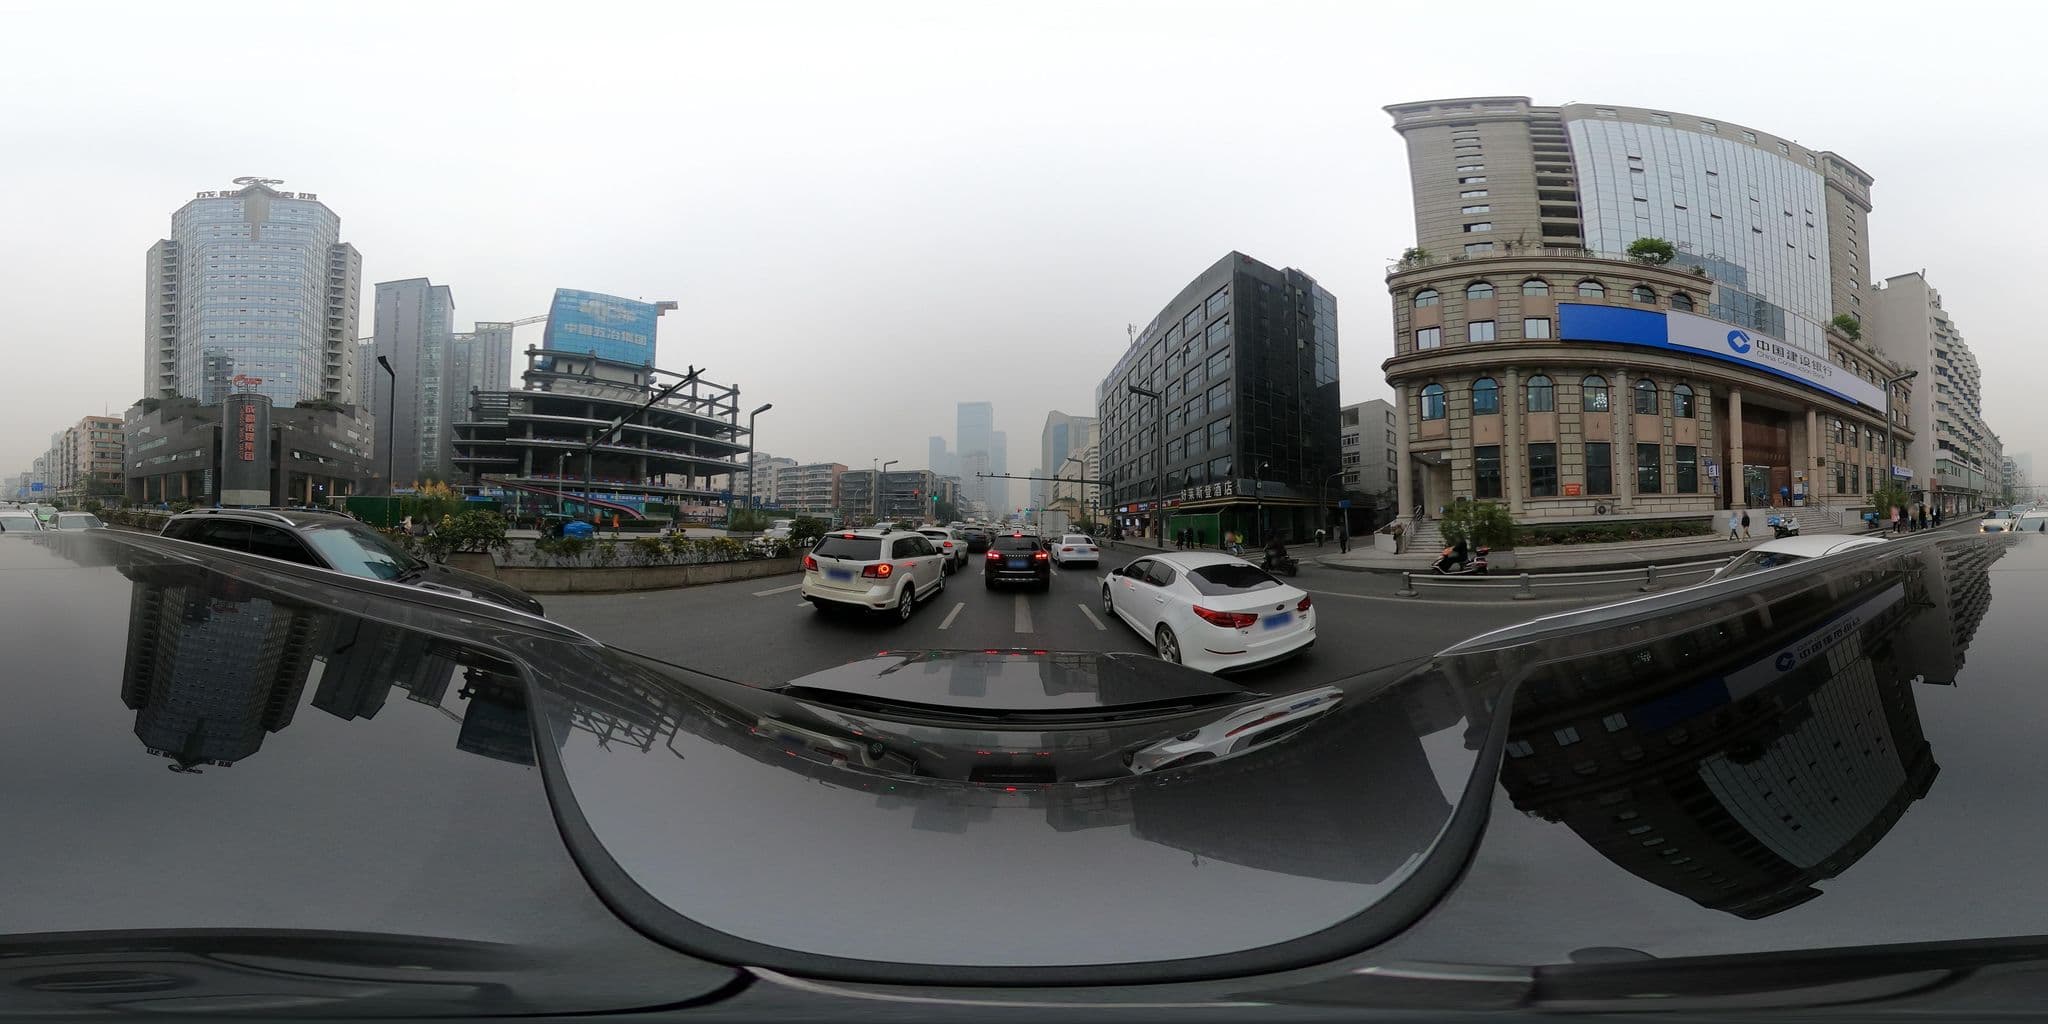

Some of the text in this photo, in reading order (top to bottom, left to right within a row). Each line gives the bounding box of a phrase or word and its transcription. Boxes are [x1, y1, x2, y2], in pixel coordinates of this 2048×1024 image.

[1756, 339, 1833, 377] 中国建设银行
